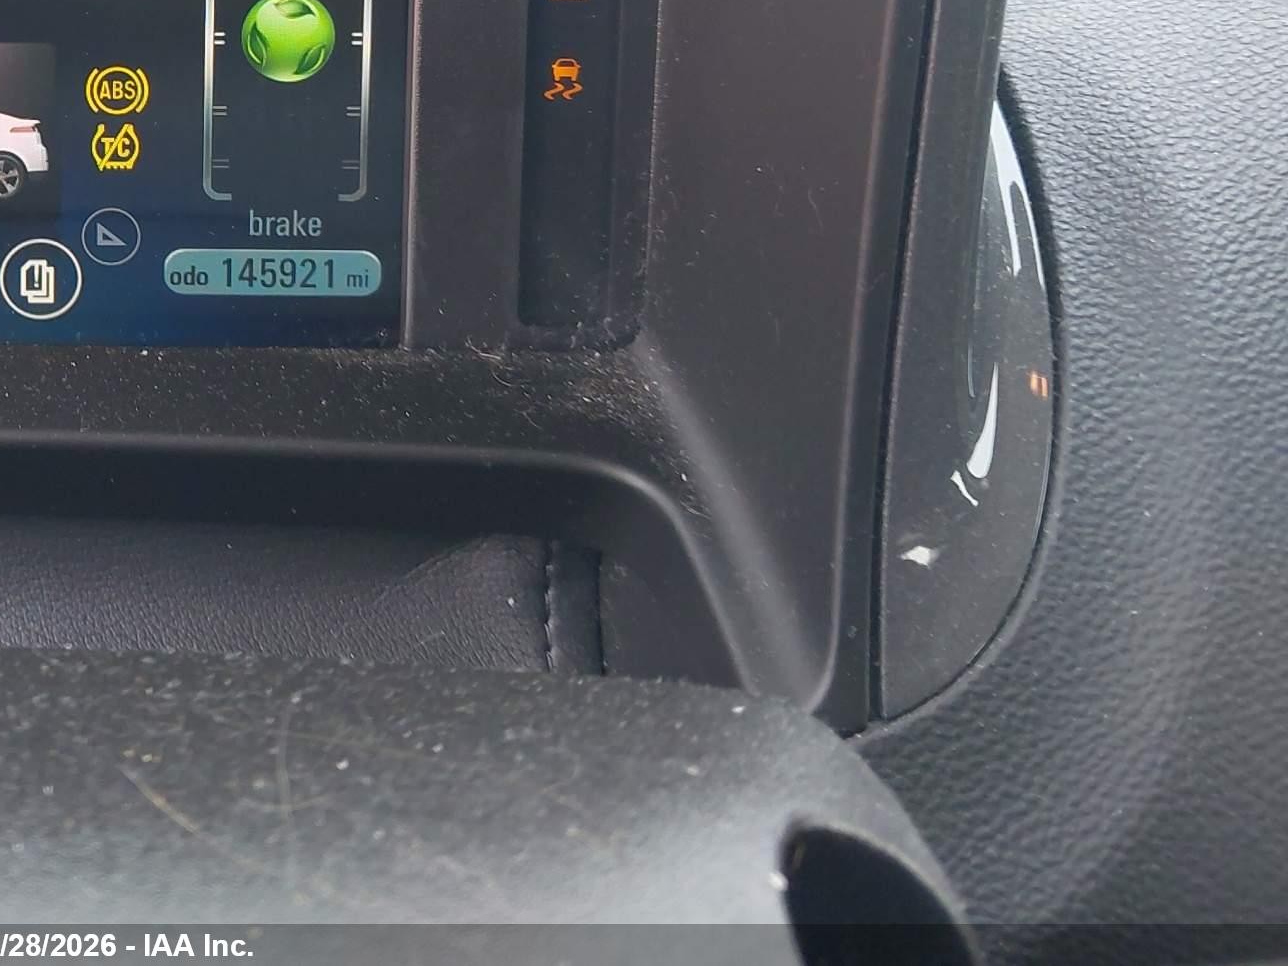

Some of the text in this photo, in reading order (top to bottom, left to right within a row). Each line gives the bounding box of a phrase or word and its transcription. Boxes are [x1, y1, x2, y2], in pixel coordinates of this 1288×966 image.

[99, 80, 137, 102] ABS
[249, 210, 322, 237] brake
[170, 258, 369, 290] odo 145921 mi
